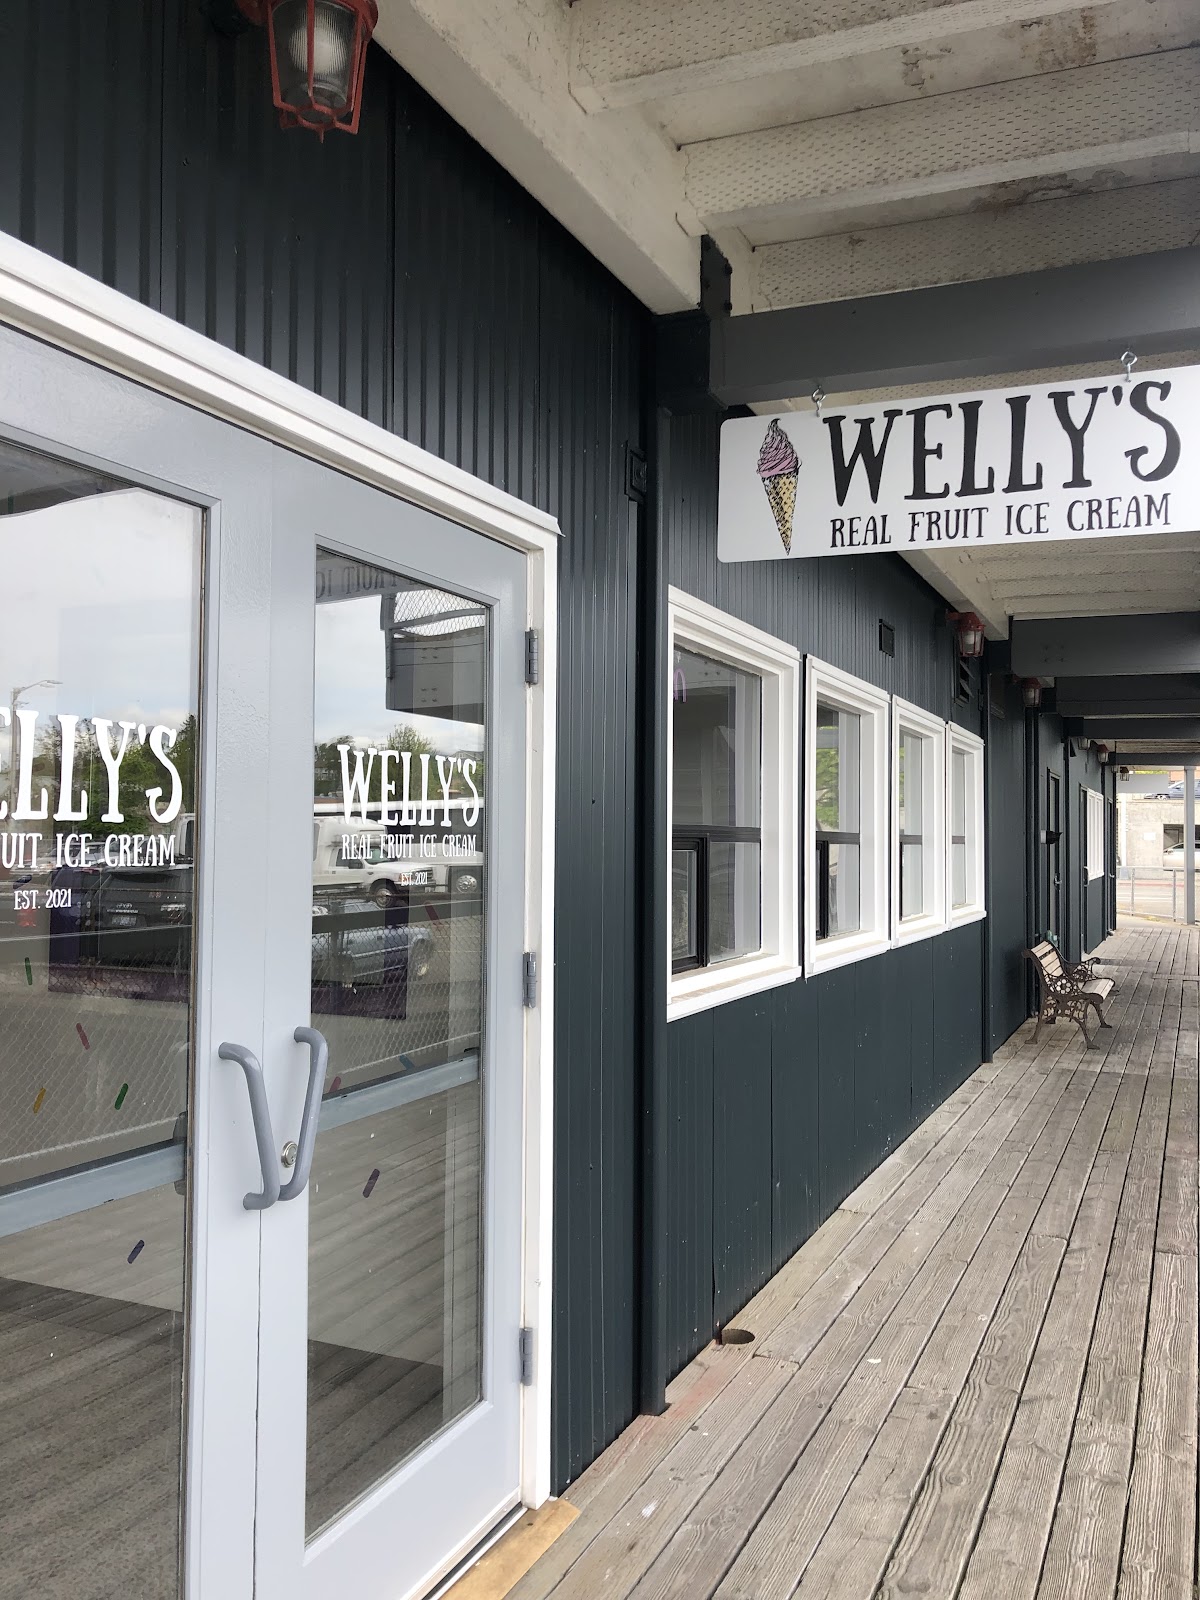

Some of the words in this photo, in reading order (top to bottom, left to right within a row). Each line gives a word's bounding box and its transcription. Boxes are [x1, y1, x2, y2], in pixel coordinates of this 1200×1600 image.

[822, 381, 1181, 507] WELLY'S
[830, 515, 892, 548] REAL
[908, 507, 989, 542] FRUIT
[1005, 502, 1050, 536] ICE
[1067, 493, 1172, 532] CREAM
[0, 706, 182, 824] LLY'S
[337, 744, 480, 828] WELLY'S
[55, 833, 93, 868] ICE
[104, 834, 176, 867] CREAM
[341, 834, 373, 860] REAL
[380, 834, 414, 859] FRUIT
[419, 834, 437, 858] ICE
[442, 834, 477, 857] CREAM
[14, 889, 41, 910] EST.
[45, 888, 72, 909] 2021
[401, 872, 414, 887] EST.
[415, 871, 428, 885] 2021
